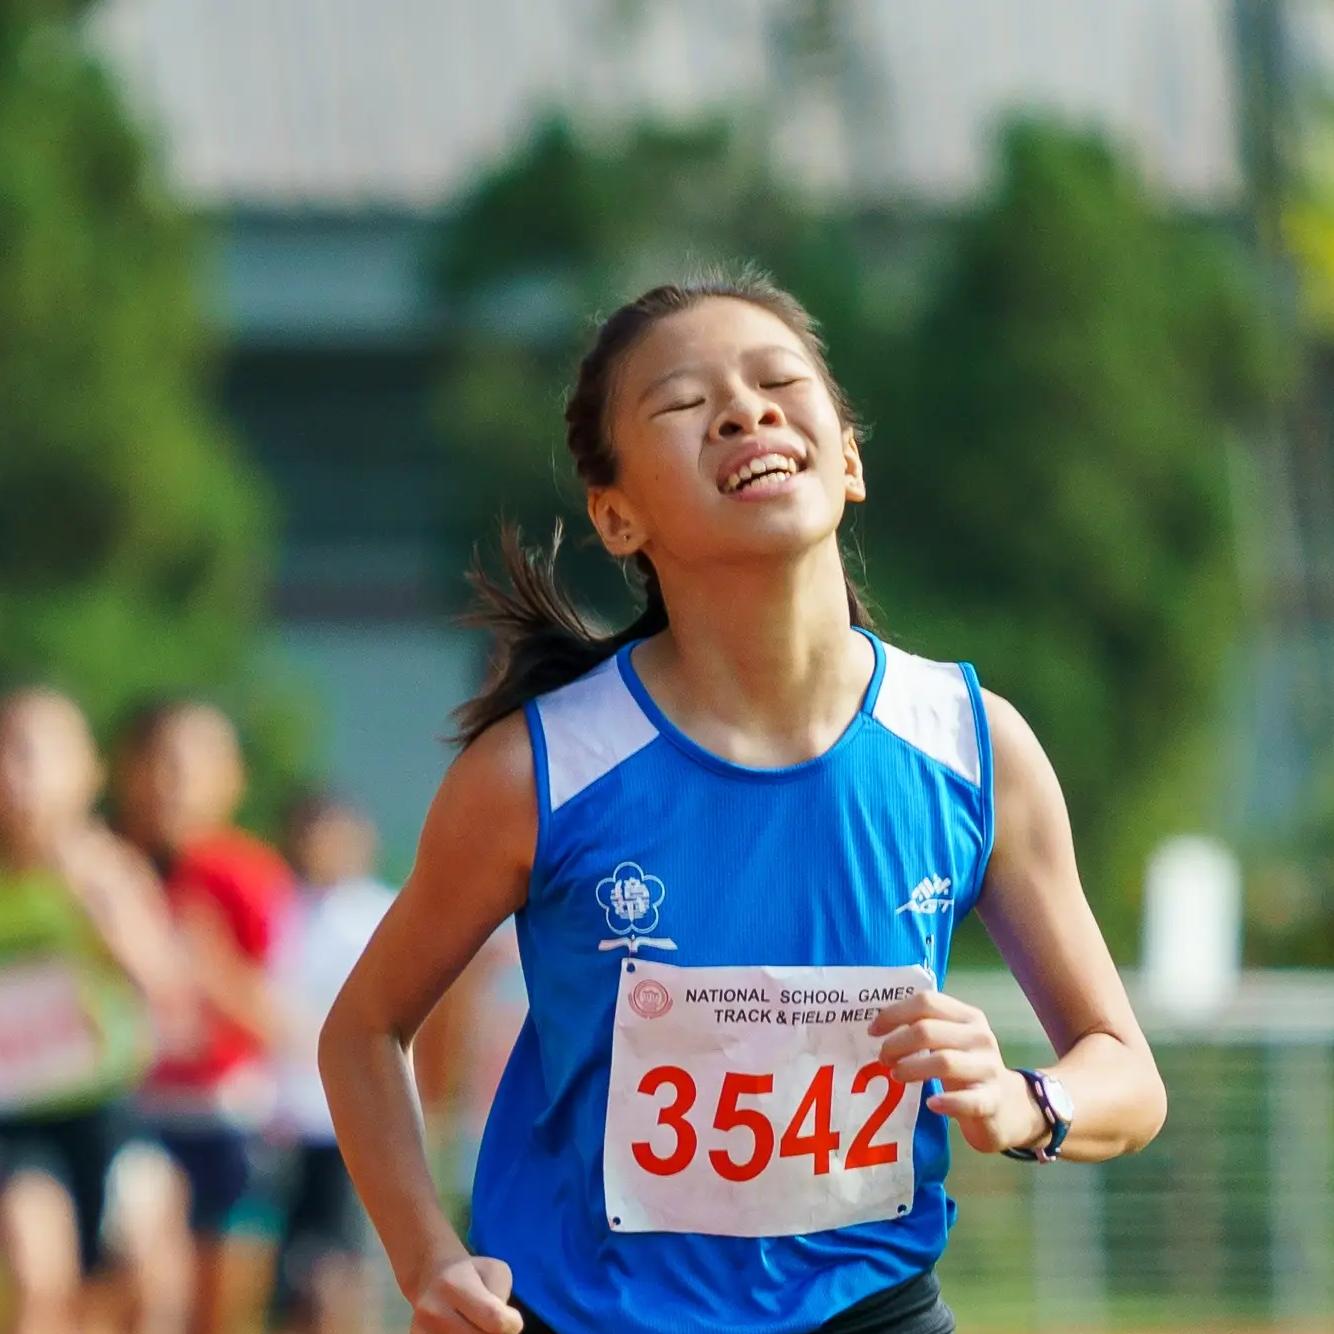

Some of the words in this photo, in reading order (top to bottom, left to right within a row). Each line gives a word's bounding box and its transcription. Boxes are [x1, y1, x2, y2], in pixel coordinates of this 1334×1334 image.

[686, 988, 770, 1003] NATIONAL
[780, 989, 849, 1005] SCHOOL
[858, 986, 915, 1003] GAMES
[714, 1009, 771, 1024] TRACK
[776, 1010, 787, 1025] &
[792, 1010, 836, 1026] FIELD
[631, 1061, 907, 1182] 3542
